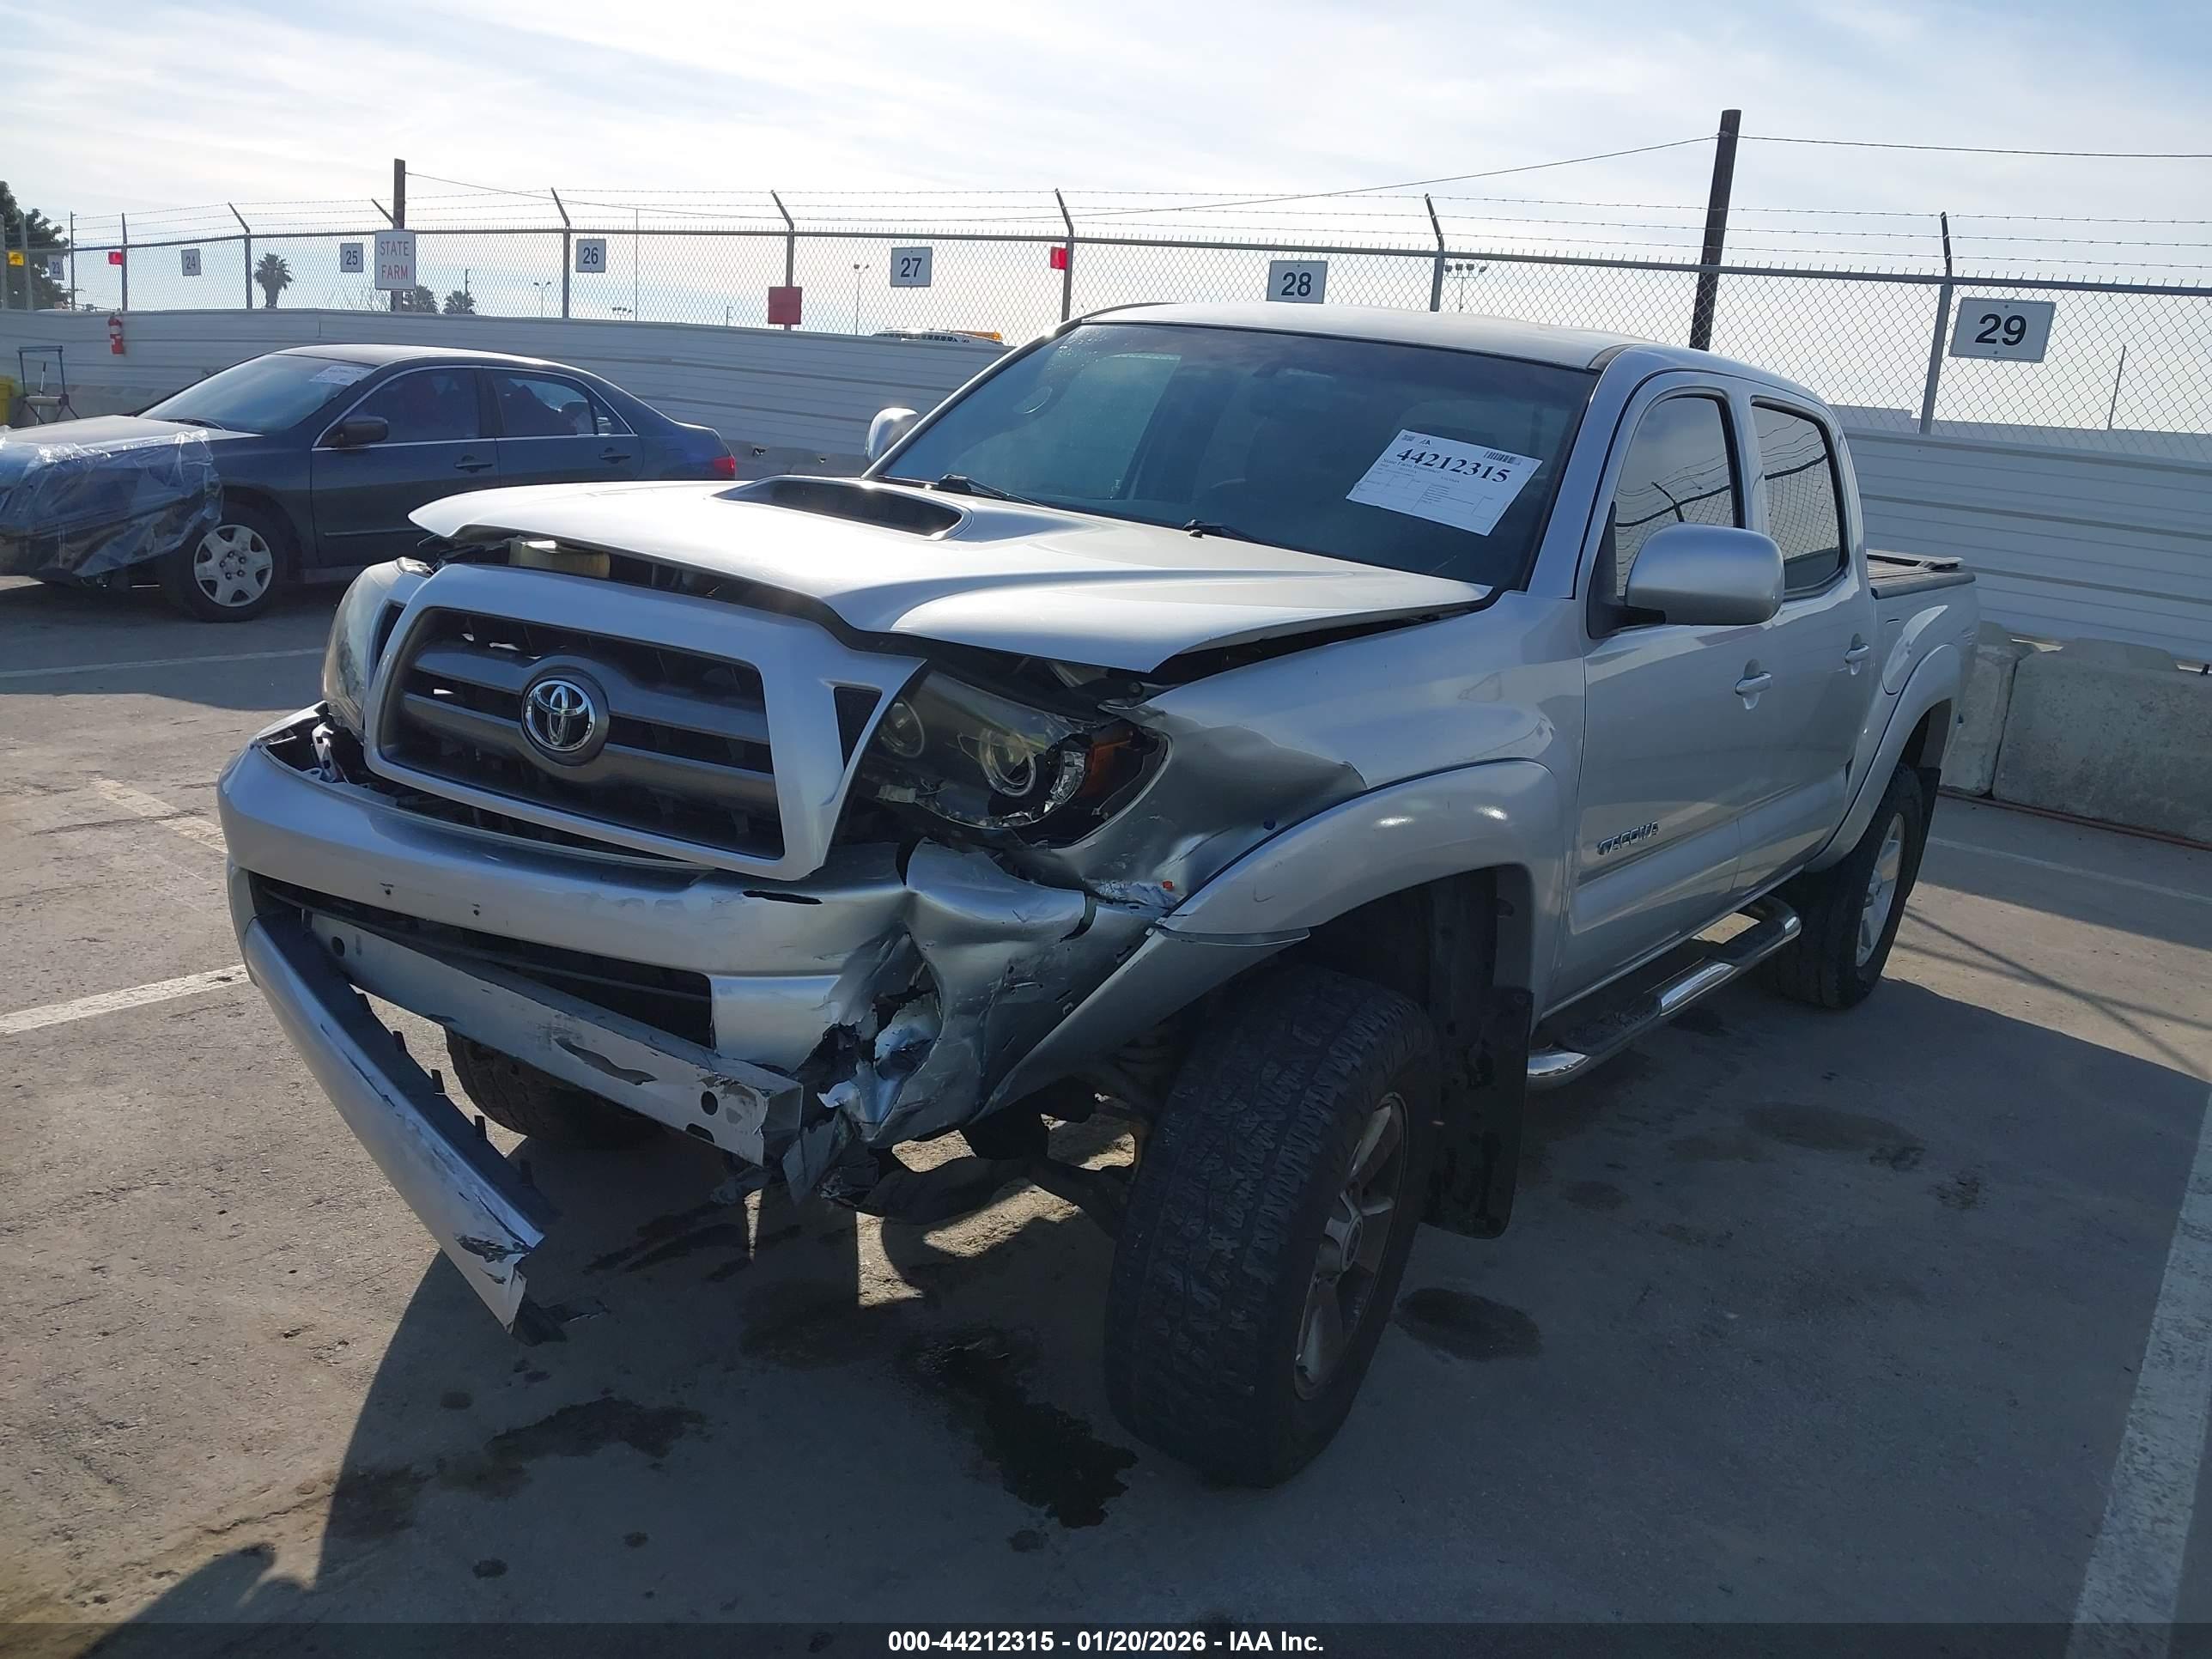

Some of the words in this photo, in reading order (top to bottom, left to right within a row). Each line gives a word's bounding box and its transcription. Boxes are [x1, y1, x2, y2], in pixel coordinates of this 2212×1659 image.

[380, 241, 410, 256] STATE
[583, 247, 599, 264] 26
[186, 256, 196, 269] 24
[345, 251, 358, 265] 25
[52, 261, 60, 274] 23
[381, 264, 409, 280] FARM
[900, 258, 922, 277] 27
[1281, 272, 1312, 296] 28
[1975, 313, 2027, 346] 29
[1396, 448, 1512, 483] 44212315
[1597, 820, 1658, 855] TACOMA
